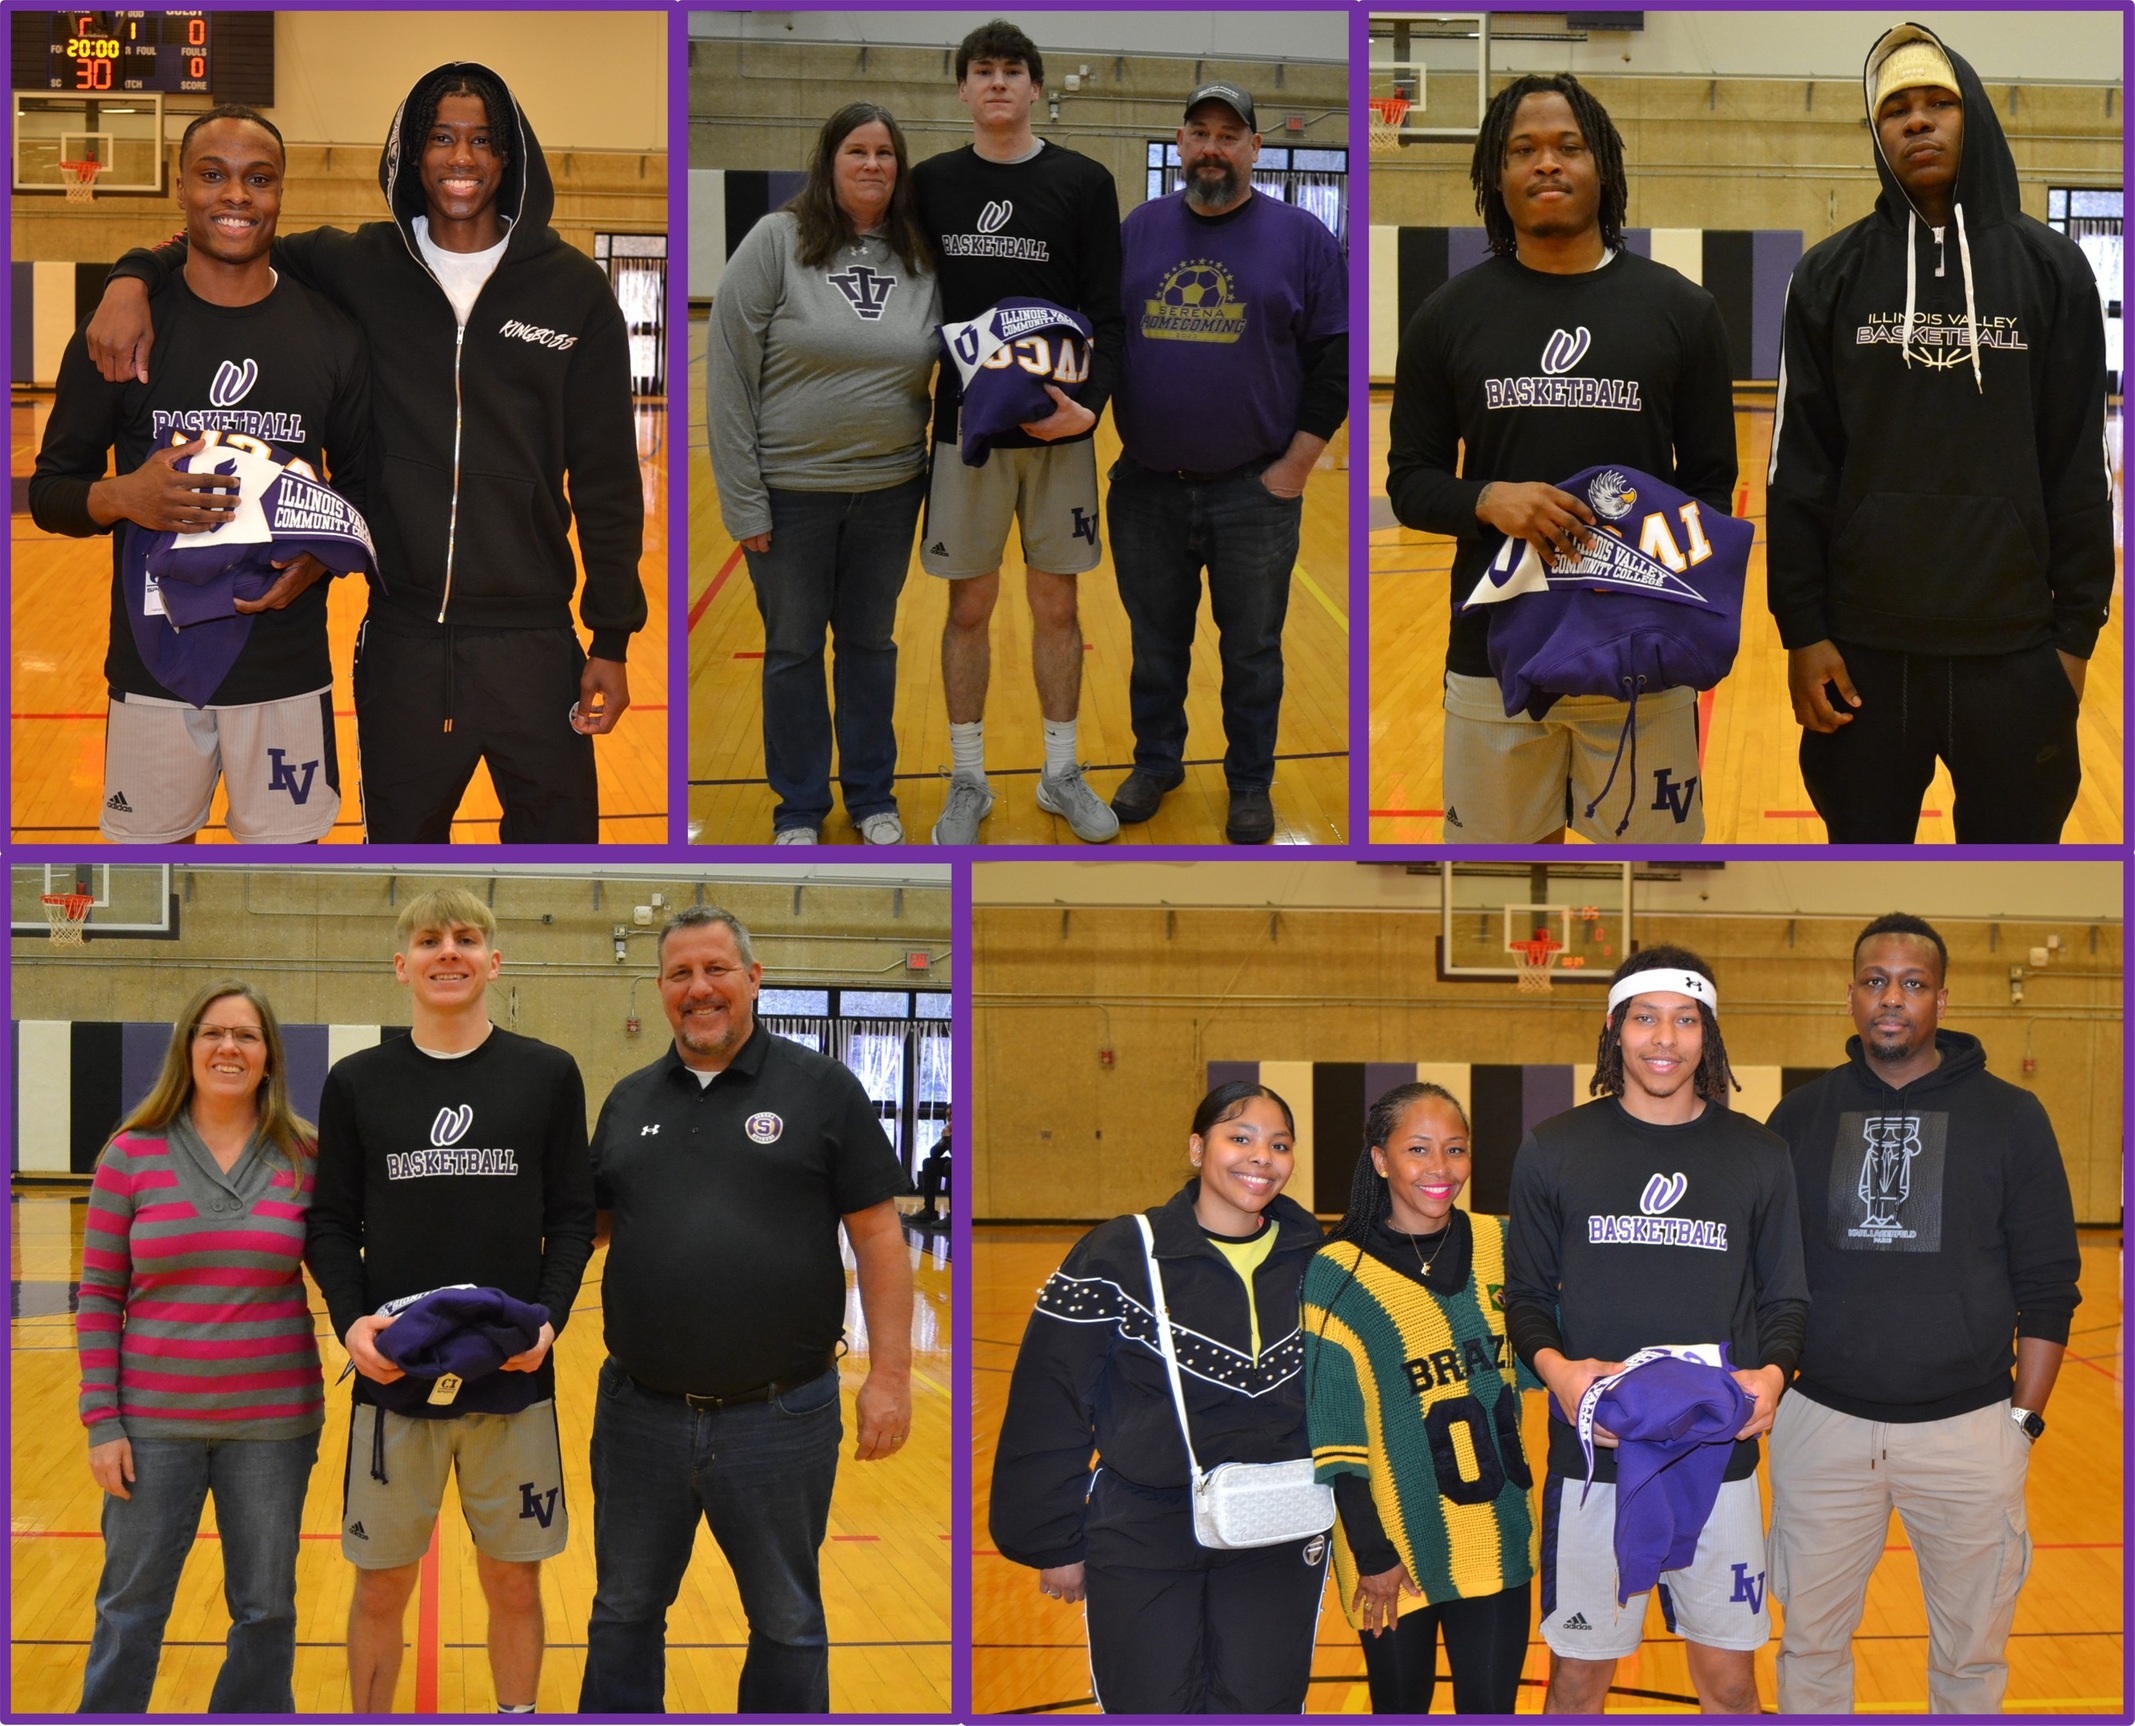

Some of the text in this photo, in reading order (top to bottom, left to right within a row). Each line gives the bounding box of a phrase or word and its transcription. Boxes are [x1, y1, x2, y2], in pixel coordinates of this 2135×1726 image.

[189, 20, 205, 45] 0
[67, 39, 120, 58] 20:00
[181, 47, 207, 56] FOULS
[76, 58, 112, 90] 30
[190, 57, 205, 78] 0
[181, 81, 207, 90] SCORE
[942, 235, 1050, 262] BASKETBALL
[1000, 309, 1049, 327] ILLINOIS
[1141, 315, 1246, 334] HOMECOMING
[1158, 306, 1225, 319] SERENA
[1948, 314, 2017, 328] VALEY
[499, 319, 579, 351] KINGBOSS
[1002, 316, 1055, 337] COMMUNITY
[1485, 377, 1642, 411] BASKETBALL
[153, 410, 305, 443] BASKETBALL
[277, 478, 345, 518] ILLINOIS
[274, 507, 351, 533] COMMUNITY
[1071, 507, 1097, 546] IV
[1614, 545, 1668, 583] VALLEY
[1613, 567, 1664, 587] COLLEGE
[267, 748, 319, 805] IV
[107, 802, 133, 813] adidas
[1651, 768, 1697, 824] IV
[757, 1119, 771, 1135] S
[386, 1149, 519, 1181] BASKETBALL
[1588, 1215, 1728, 1251] BASKETBALL
[441, 1378, 459, 1389] CI
[519, 1482, 558, 1529] IV
[1730, 1563, 1765, 1615] IV
[1563, 1622, 1592, 1631] adidas
